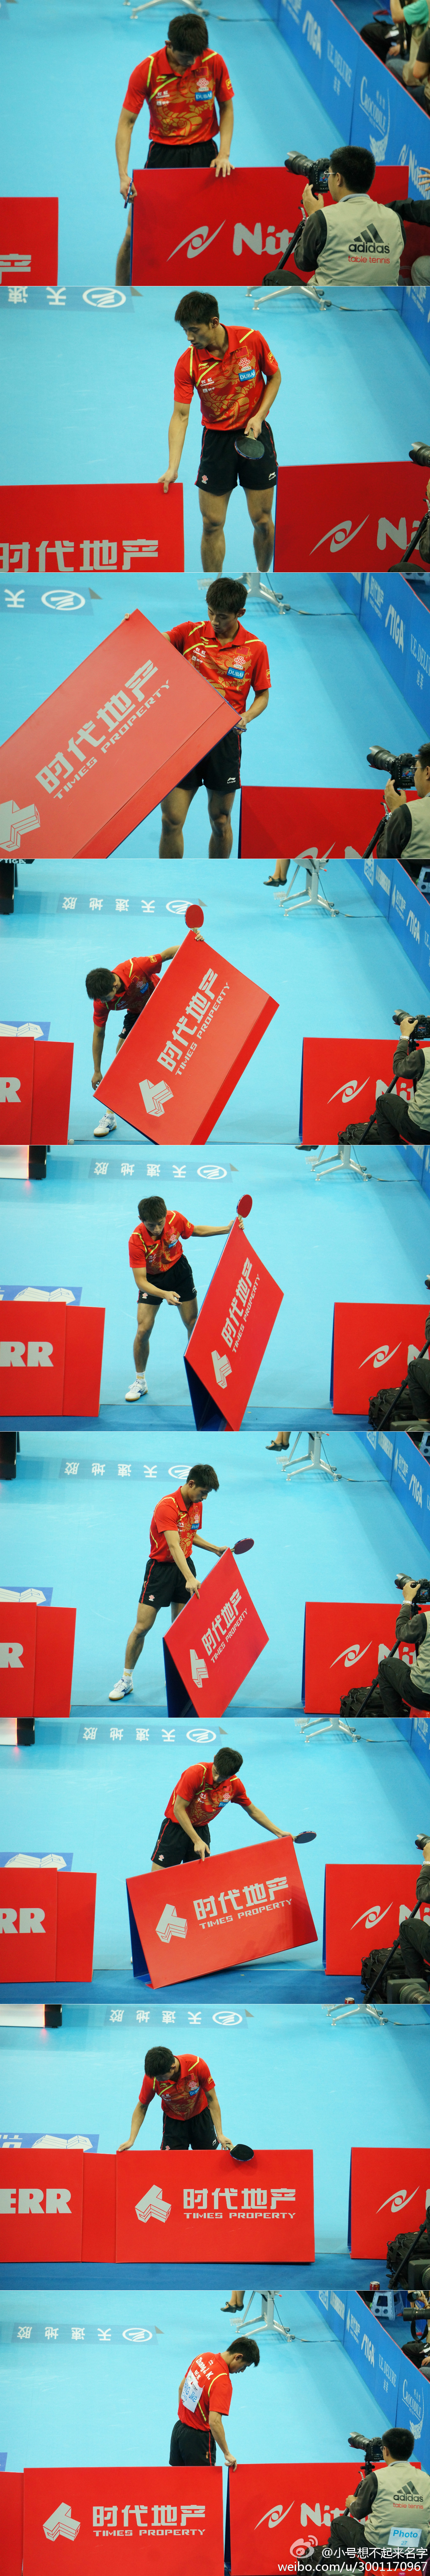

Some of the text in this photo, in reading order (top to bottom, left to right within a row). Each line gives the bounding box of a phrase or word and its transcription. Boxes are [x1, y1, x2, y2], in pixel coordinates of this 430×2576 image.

[348, 242, 390, 254] adidas
[240, 371, 255, 380] DUBAI
[0, 539, 159, 572] 时代地产
[35, 659, 159, 794] 时代地产
[53, 679, 170, 799] TIMES PROPERTY
[157, 968, 219, 1072] 时代地产
[175, 982, 230, 1075] TIMES PROPERTY
[221, 1257, 253, 1348] 时代地产
[232, 1273, 260, 1353] TIMES PROPERTY
[201, 1588, 242, 1656] 时代地产
[211, 1608, 248, 1663] TIMES PROPERTY
[193, 1876, 289, 1920] 时代地产
[199, 1898, 292, 1929] TIMES PROPERTY
[183, 2188, 296, 2210] 时代地产
[196, 2357, 206, 2372] Zhang
[205, 2371, 214, 2380] K.
[384, 2361, 397, 2388] DELURE
[189, 2391, 197, 2402] Jike
[403, 2379, 421, 2419] CROCODILE
[393, 2493, 424, 2502] adidas
[93, 2505, 205, 2527] 时代地产
[393, 2530, 418, 2538] Photo
